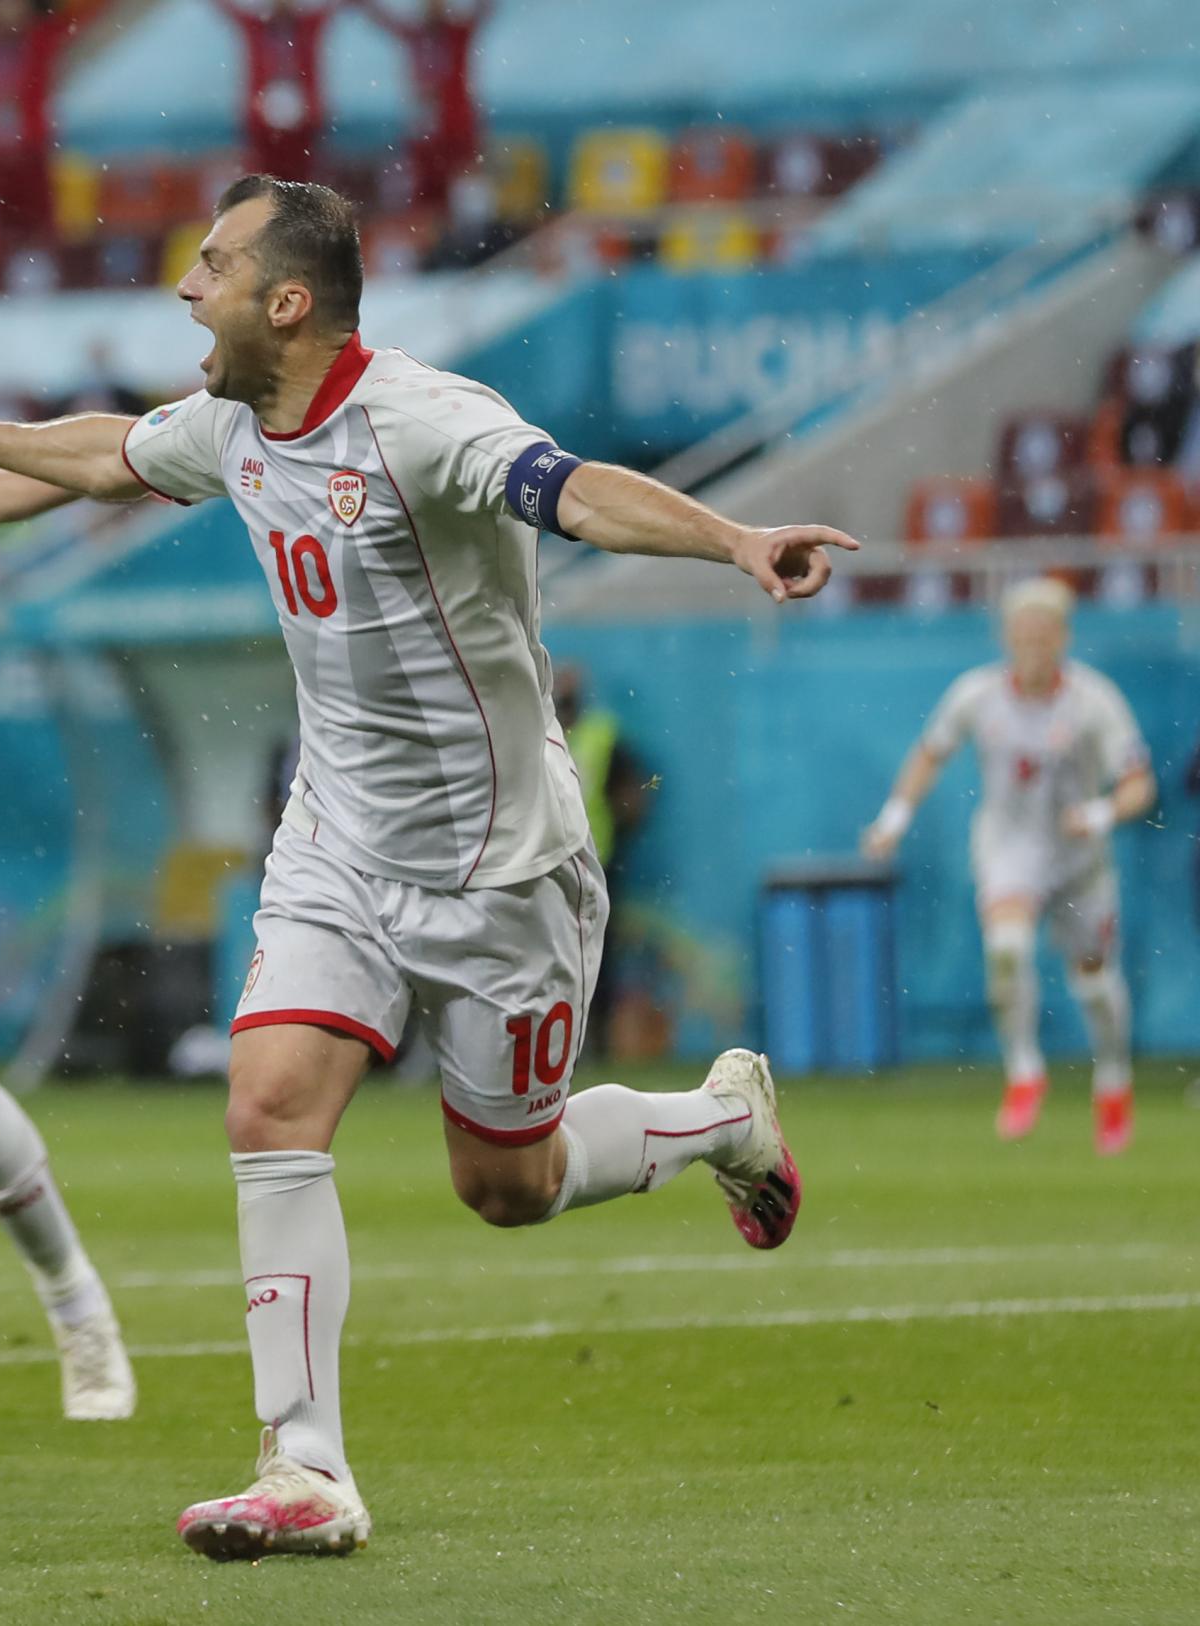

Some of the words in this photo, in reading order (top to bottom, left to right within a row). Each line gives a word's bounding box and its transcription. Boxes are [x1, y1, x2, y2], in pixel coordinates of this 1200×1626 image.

[241, 457, 264, 476] JAKO
[269, 530, 337, 618] 10
[506, 1001, 573, 1095] 10
[526, 1089, 561, 1114] JAKO
